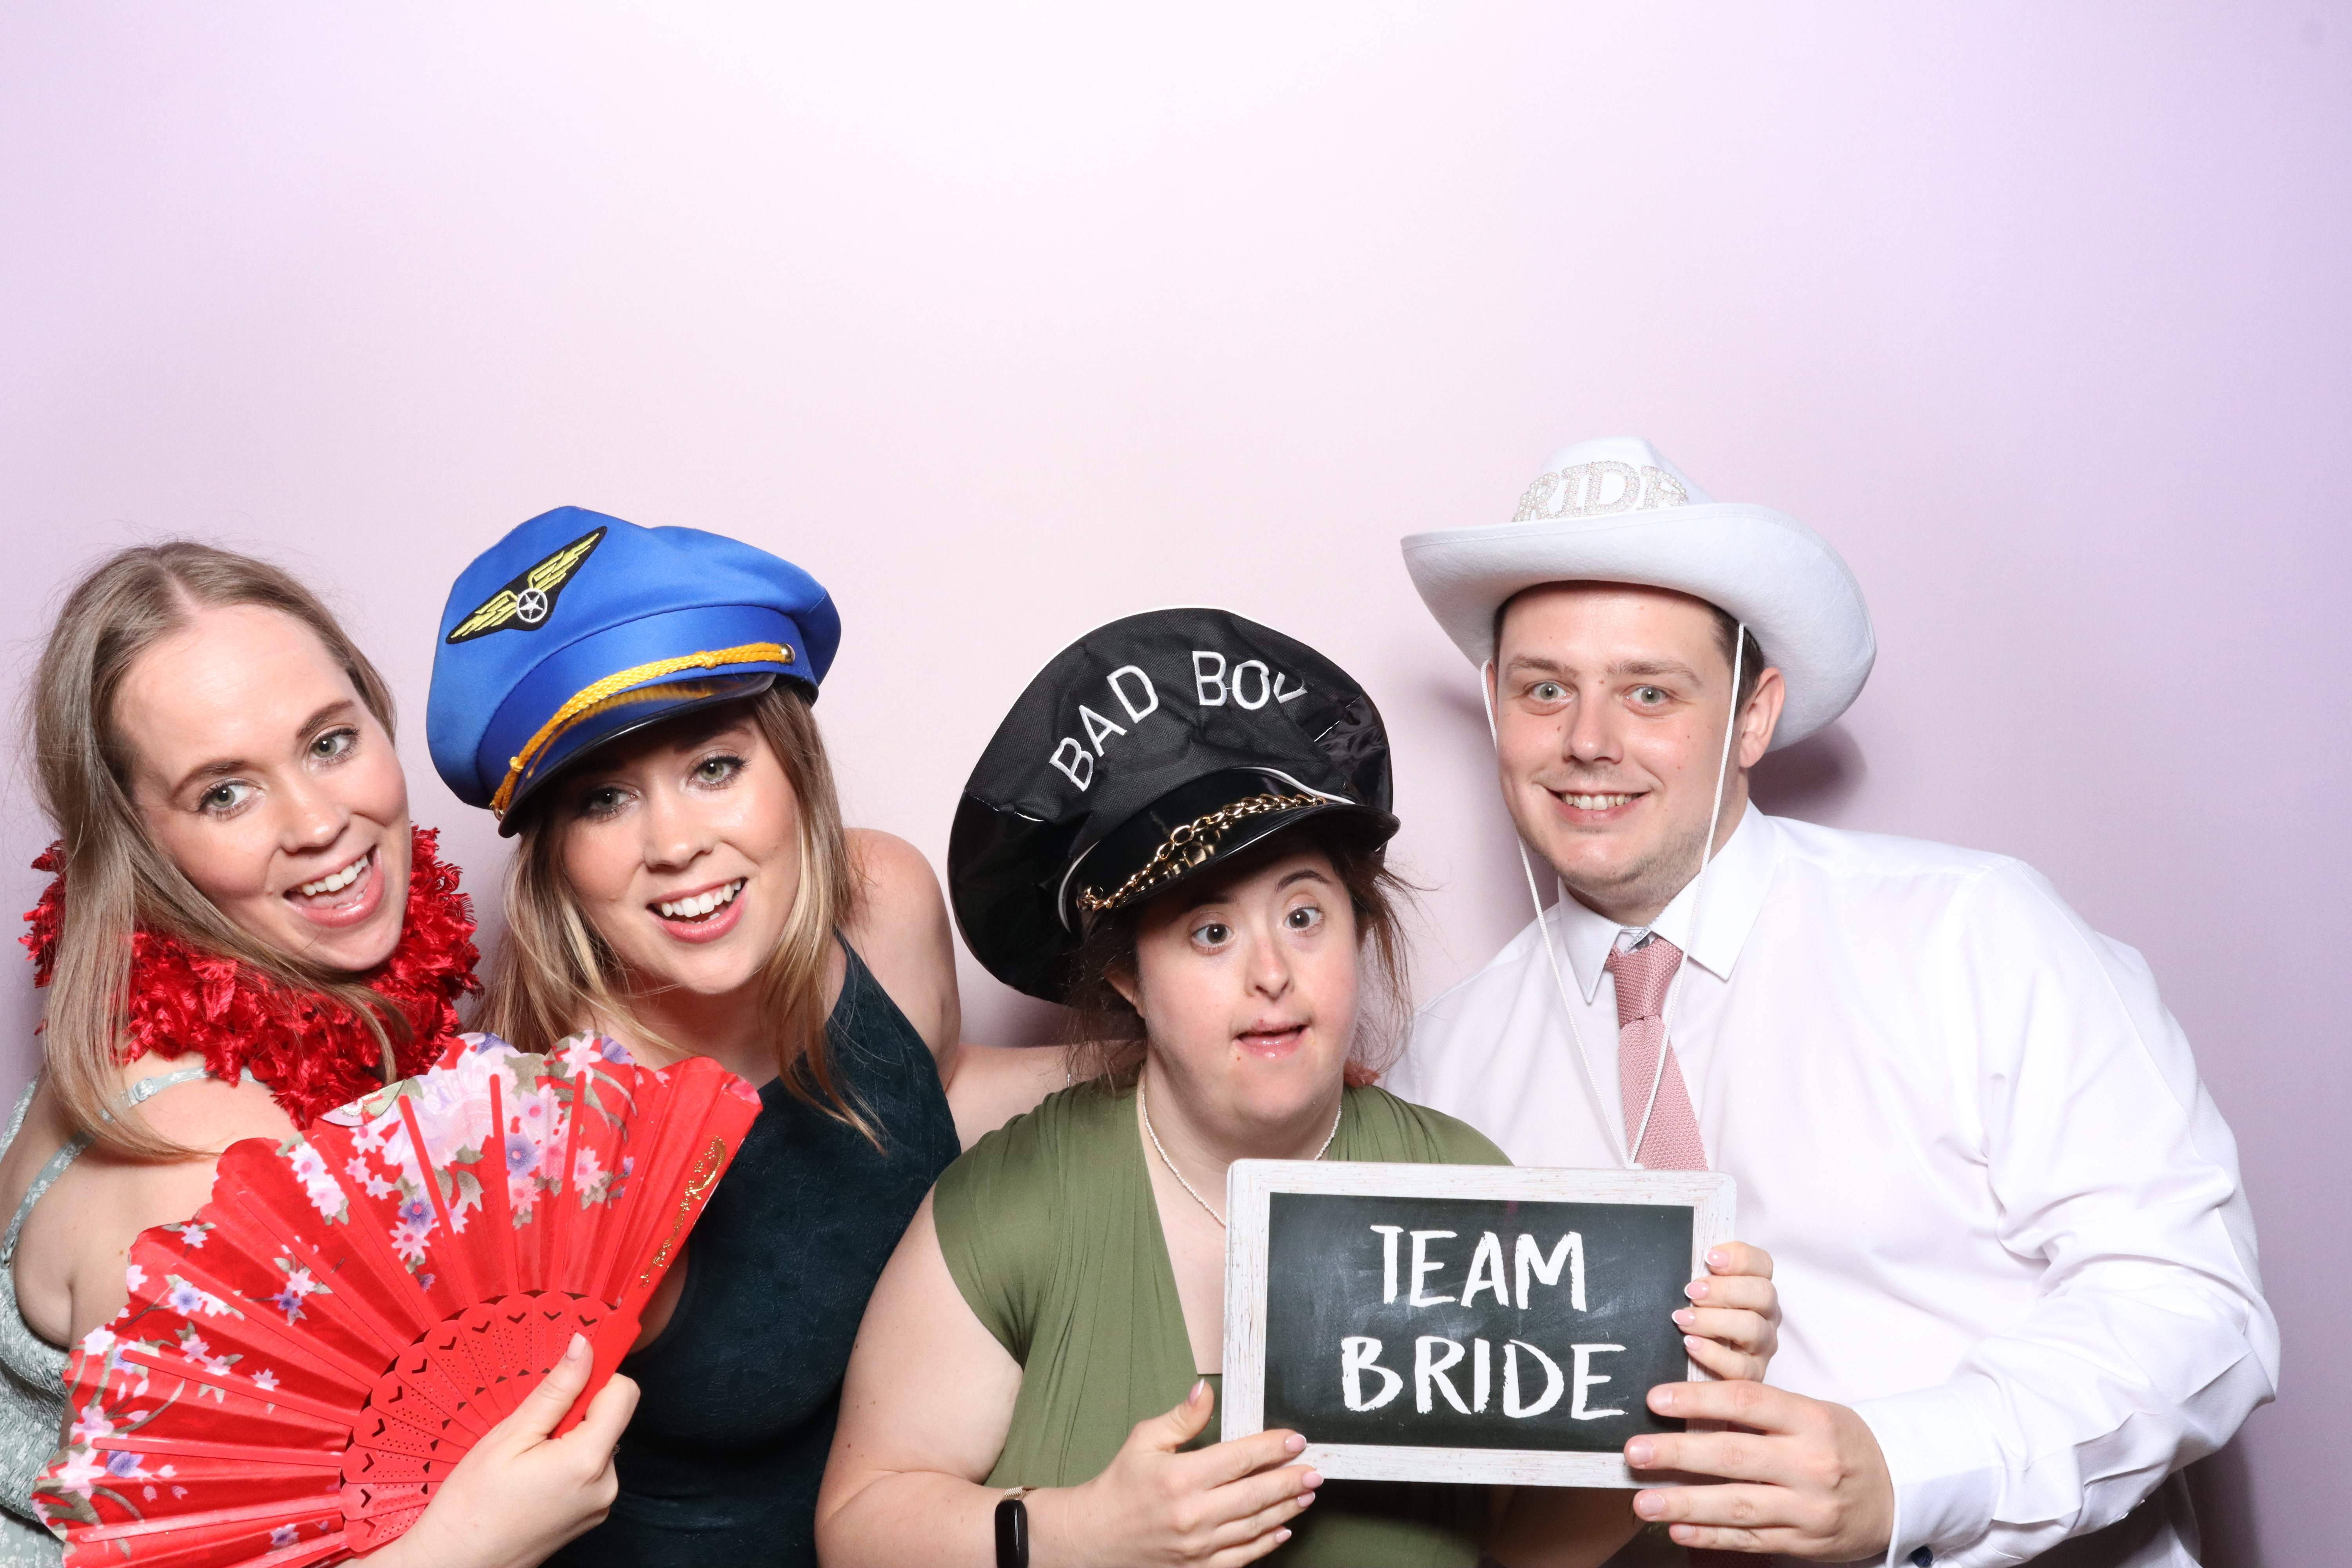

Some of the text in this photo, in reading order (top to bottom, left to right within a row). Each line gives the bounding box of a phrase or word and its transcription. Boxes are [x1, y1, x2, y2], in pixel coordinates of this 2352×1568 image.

[1050, 665, 1159, 792] BAD
[1370, 1225, 1587, 1312] TEAM
[1341, 1336, 1628, 1420] BRIDE
